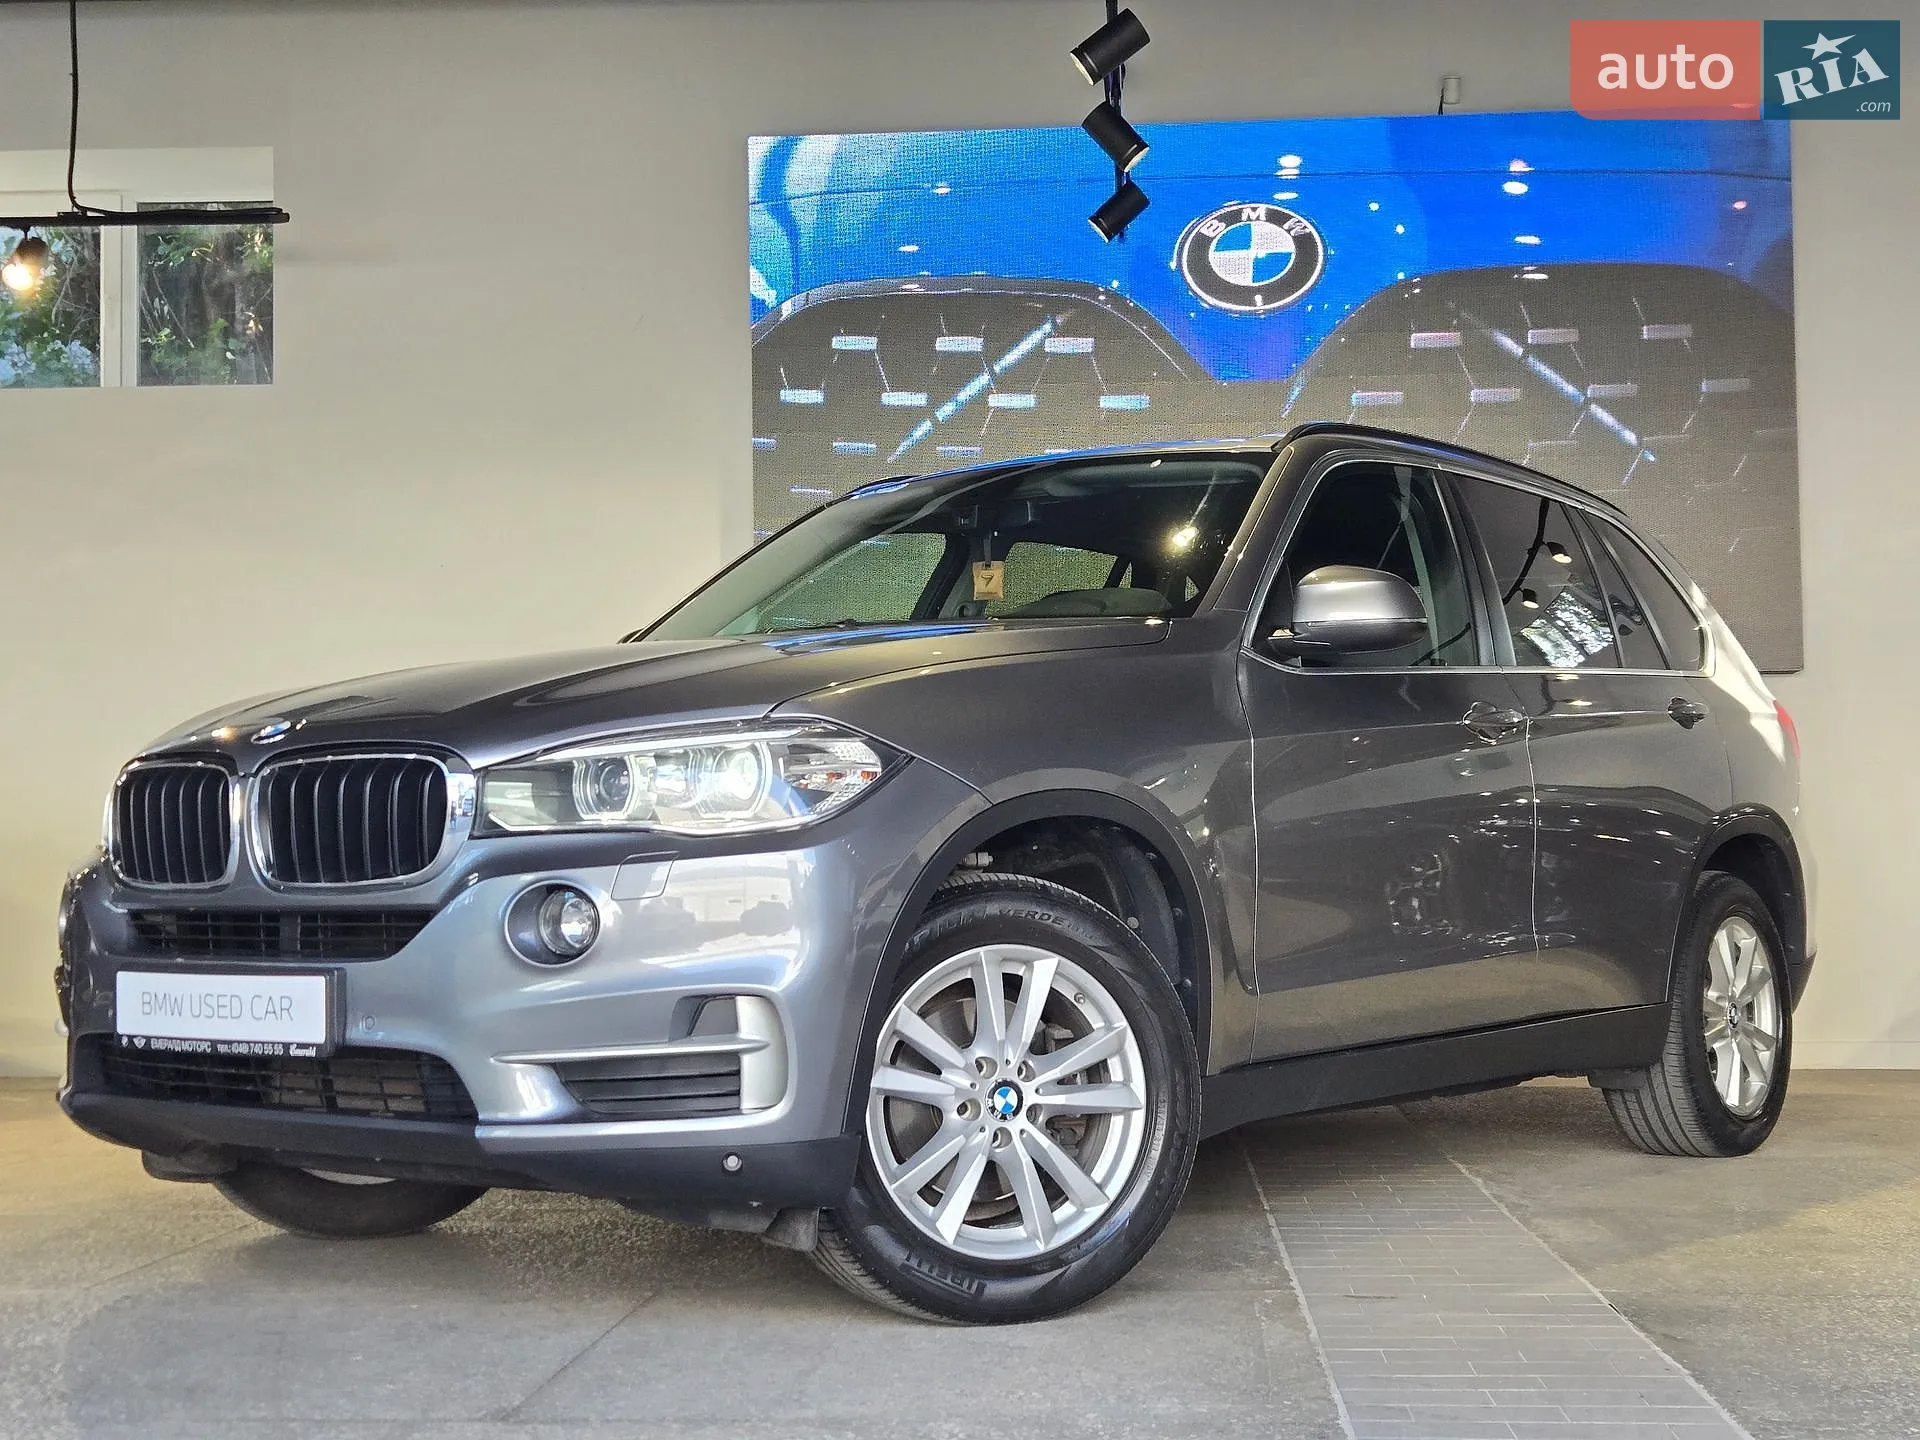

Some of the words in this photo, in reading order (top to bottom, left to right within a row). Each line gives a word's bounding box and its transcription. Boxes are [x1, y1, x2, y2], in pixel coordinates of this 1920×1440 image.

[1199, 205, 1310, 238] BMW
[141, 991, 185, 1017] BMW
[190, 993, 243, 1019] USED
[250, 994, 294, 1021] CAR
